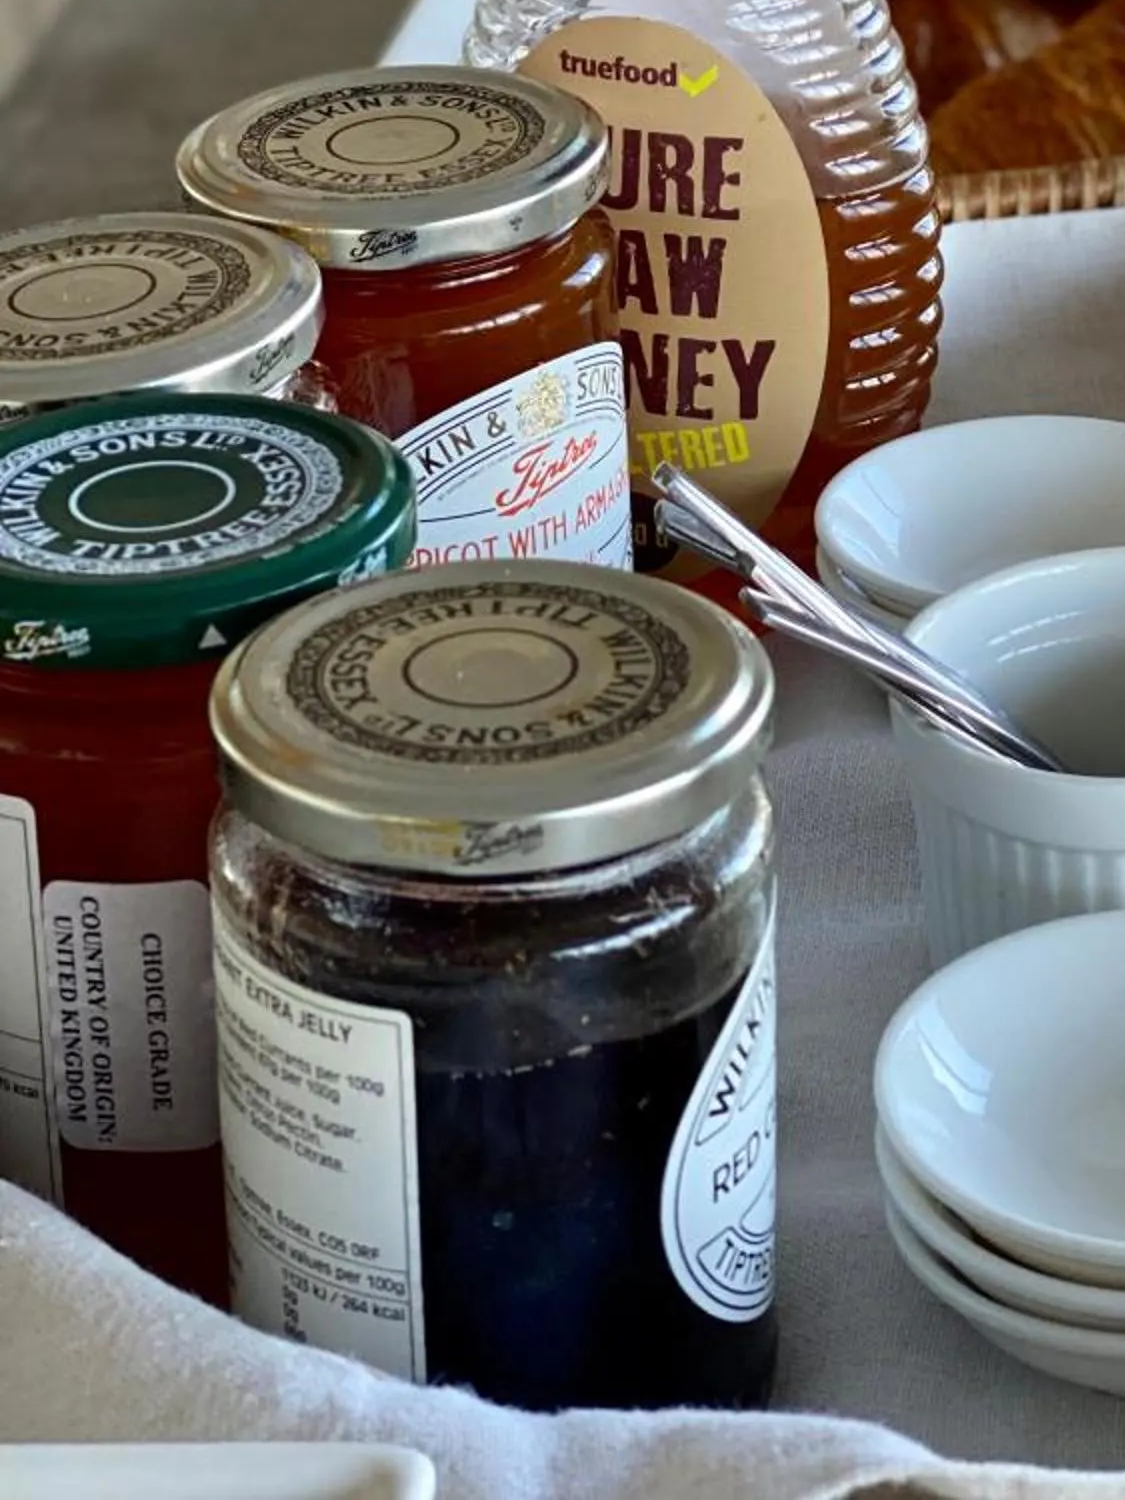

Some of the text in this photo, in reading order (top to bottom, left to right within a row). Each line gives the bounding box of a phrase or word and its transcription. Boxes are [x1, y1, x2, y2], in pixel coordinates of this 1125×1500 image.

[559, 49, 677, 87] truefood
[274, 96, 381, 140] WILKIN
[389, 95, 411, 108] &
[417, 95, 500, 121] SONS
[270, 136, 508, 185] TIPTREE ESSEX
[603, 125, 744, 220] URE
[127, 268, 219, 331] WILKIN
[617, 230, 727, 318] AW
[98, 325, 122, 339] &
[621, 329, 776, 420] NEY
[417, 426, 476, 481] KIN
[487, 411, 506, 438] &
[629, 420, 750, 476] TERED
[1, 465, 61, 548] WILKIN
[44, 455, 73, 475] &
[70, 431, 187, 463] SONS
[71, 443, 301, 559] TIPTREE ESSEX
[509, 510, 567, 561] WITH
[329, 600, 598, 711] TIPTREE ESSEX
[594, 627, 656, 718] WILKIN
[422, 721, 558, 747] SONS
[79, 895, 109, 1009] COUNTRY
[54, 915, 87, 1124] UNITED KINGDOM
[88, 1015, 111, 1051] OF
[141, 932, 173, 1112] CHOICE GRADE
[245, 977, 294, 1023] EXTRA
[298, 1011, 353, 1044] JELLY
[346, 1074, 385, 1098] 100g
[711, 1129, 762, 1205] RED
[334, 1266, 363, 1286] per
[366, 1273, 406, 1297] 100g
[715, 1236, 772, 1286] TIPTRE
